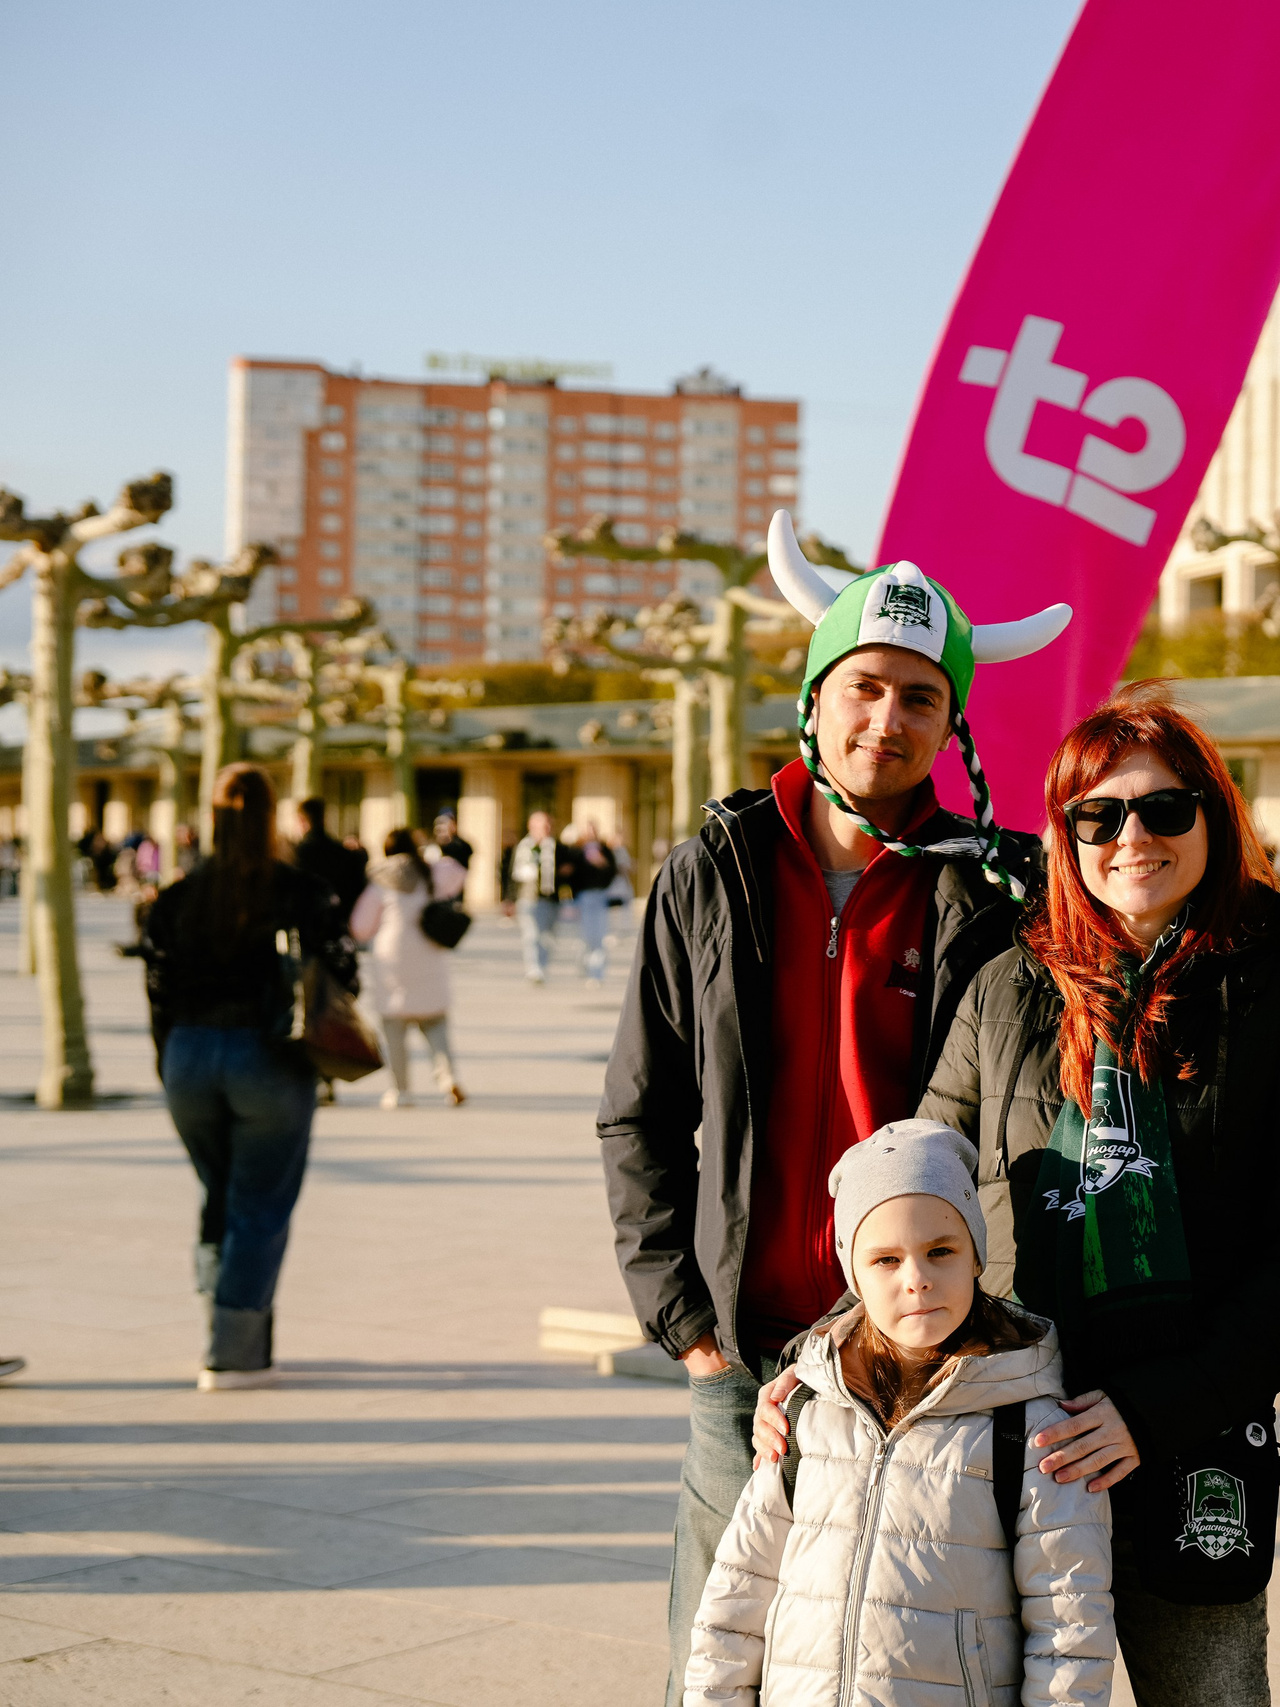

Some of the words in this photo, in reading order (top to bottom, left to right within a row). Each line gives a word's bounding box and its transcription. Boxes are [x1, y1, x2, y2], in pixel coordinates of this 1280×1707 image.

[958, 314, 1187, 547] t2
[1087, 1144, 1136, 1159] нодар
[1187, 1521, 1243, 1537] Краснодар
